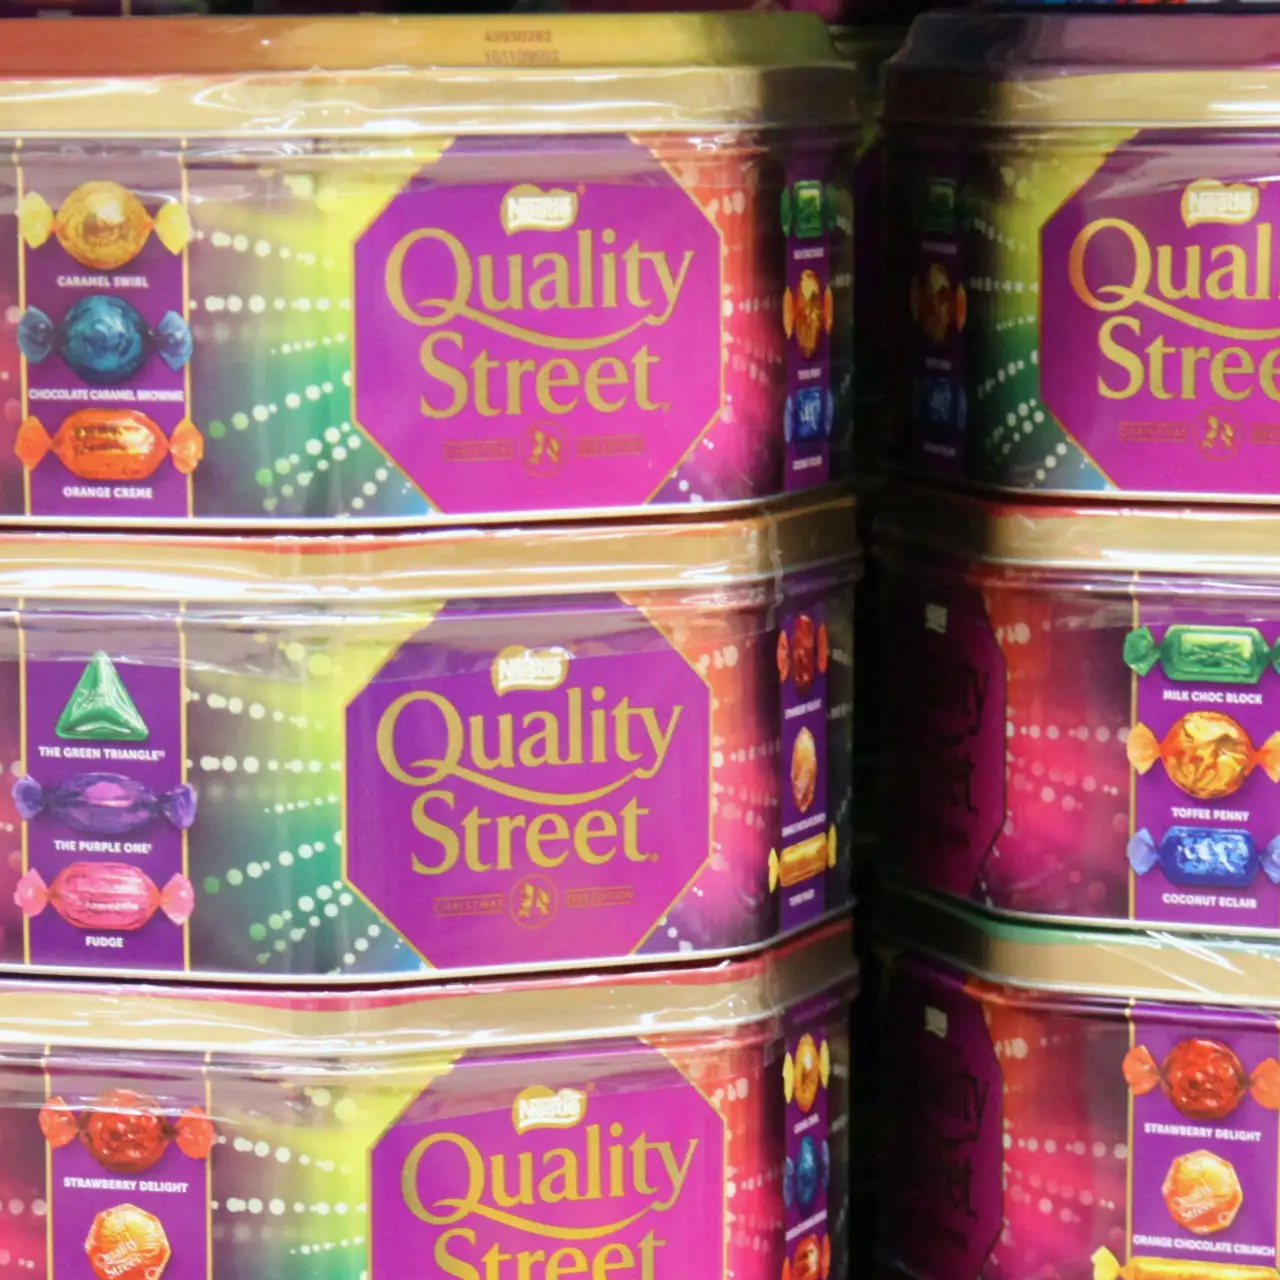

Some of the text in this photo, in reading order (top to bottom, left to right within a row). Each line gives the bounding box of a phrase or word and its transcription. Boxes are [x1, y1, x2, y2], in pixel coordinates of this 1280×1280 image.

[385, 228, 694, 350] Quality
[420, 331, 662, 419] Street
[63, 487, 152, 498] ORANGE CREME
[1163, 690, 1262, 704] MILK CHOC BLOCK
[39, 746, 61, 757] THE
[63, 748, 101, 758] GREEN
[376, 686, 683, 805] Quality
[1172, 808, 1249, 821] TOFFEE PENNY
[411, 790, 652, 875] Street
[55, 840, 76, 850] THE
[79, 841, 121, 852] PURPLE
[1163, 894, 1257, 908] COCONUT ECLAIR
[86, 936, 123, 947] FUDGE
[1144, 1123, 1261, 1141] STRAWBERRY DELIGHT
[64, 1178, 188, 1192] STRAWBERRY DELIGHT
[402, 1122, 699, 1238] Quality
[1133, 1234, 1275, 1257] ORANGE CHOCOLATE CRUNCH
